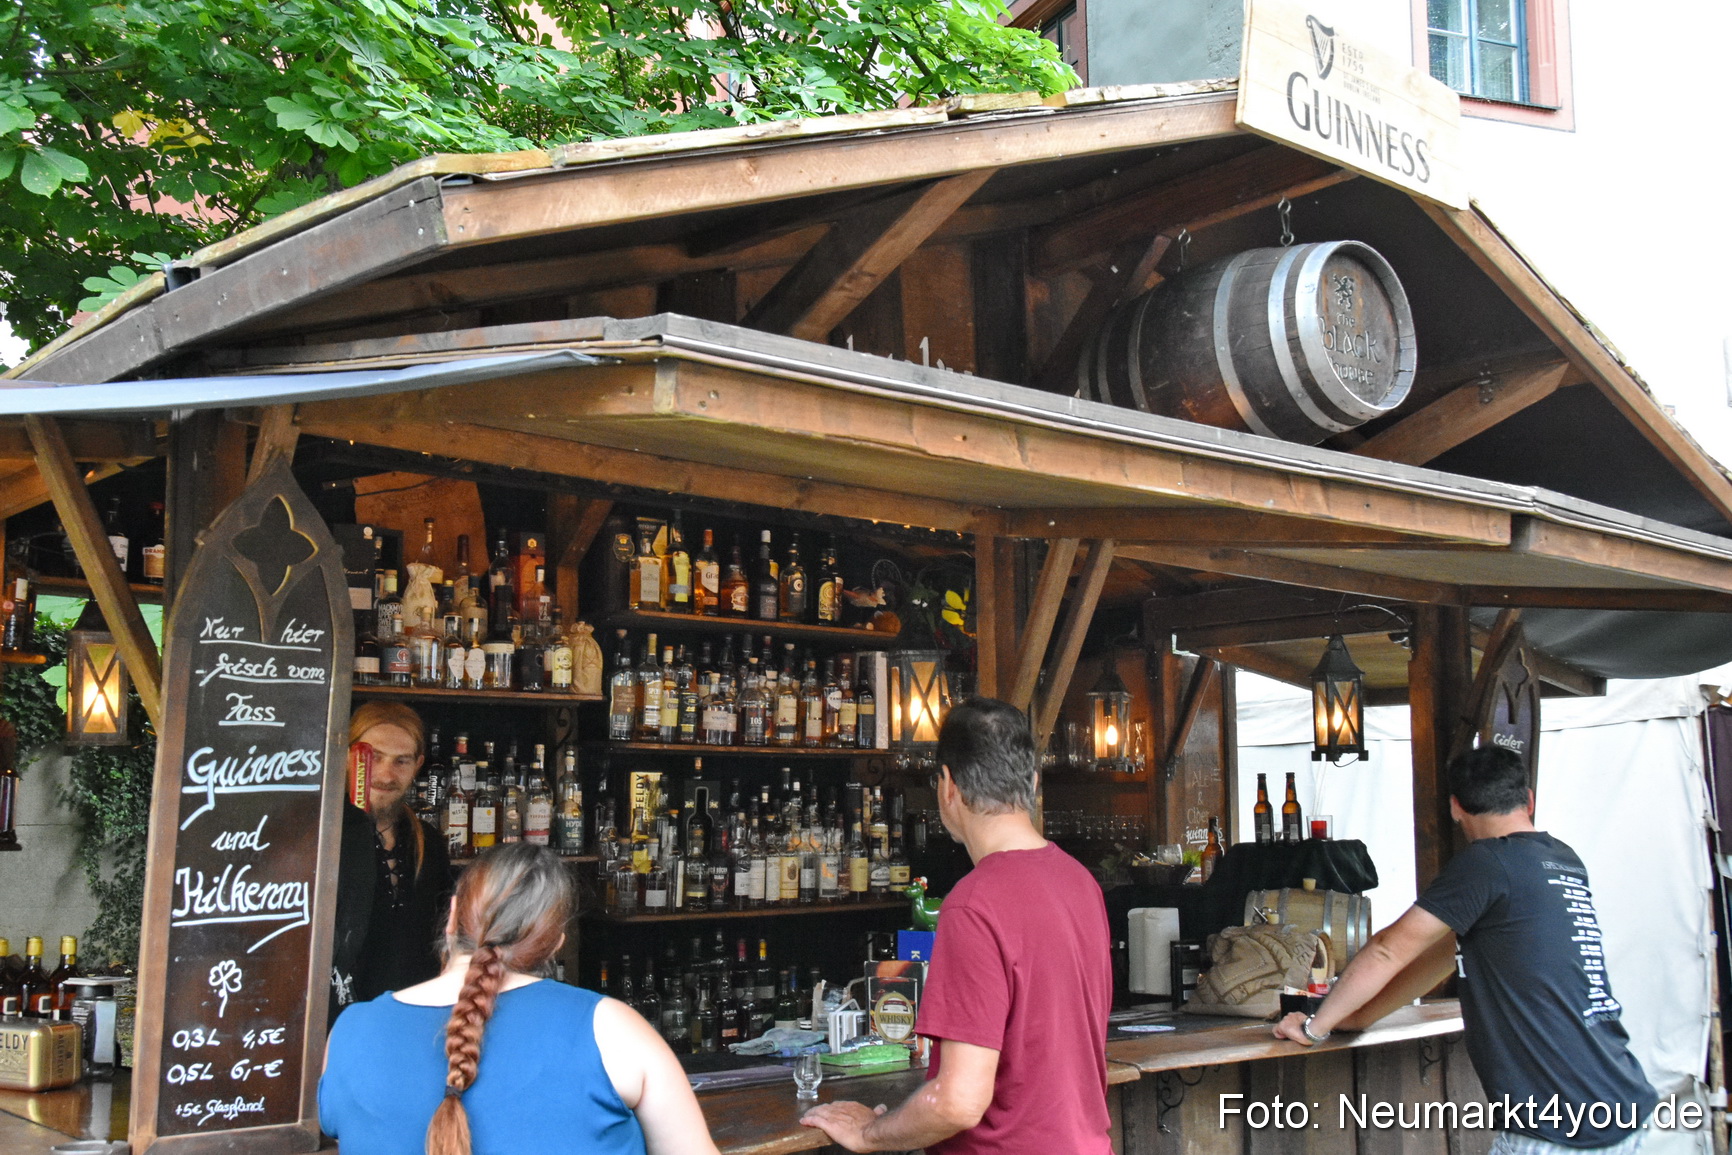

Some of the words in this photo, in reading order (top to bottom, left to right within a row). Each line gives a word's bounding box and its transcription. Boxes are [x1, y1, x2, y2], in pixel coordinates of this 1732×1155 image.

[1342, 55, 1364, 75] 1759
[1287, 71, 1431, 184] GUINNESS
[200, 617, 245, 639] Nur
[280, 618, 325, 643] hier
[199, 653, 278, 687] frisch
[287, 665, 325, 680] vom
[225, 692, 276, 721] Fass
[1493, 733, 1524, 750] Cider
[211, 815, 270, 851] und
[172, 864, 310, 954] Kilkenny
[880, 1014, 913, 1024] WHISKY
